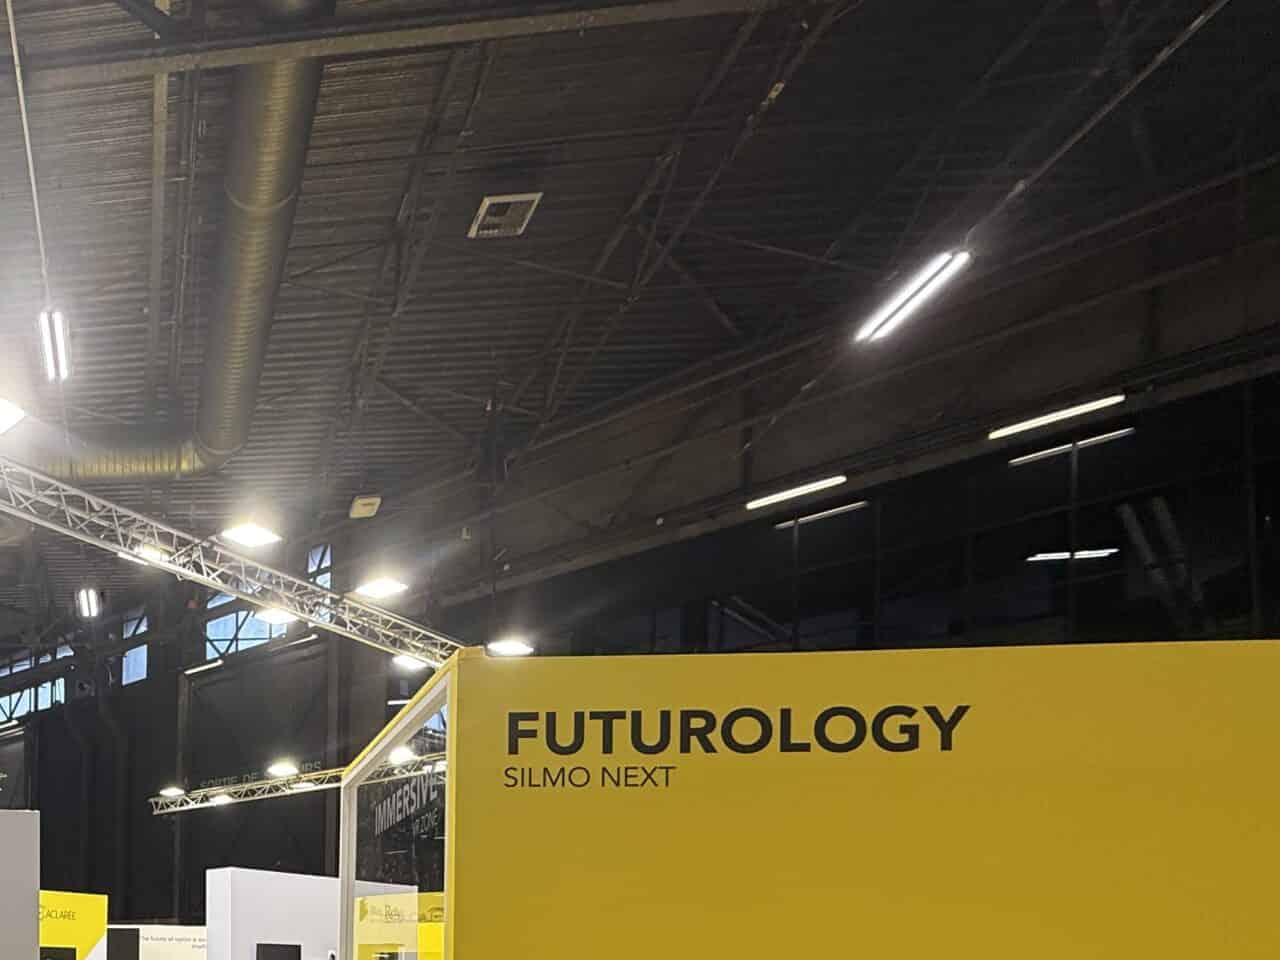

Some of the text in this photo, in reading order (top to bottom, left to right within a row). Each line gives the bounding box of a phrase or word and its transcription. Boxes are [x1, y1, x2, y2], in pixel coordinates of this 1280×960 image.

[507, 705, 972, 756] FUTUROLOGY
[503, 765, 677, 788] SILMO NEXT
[375, 770, 437, 837] IMMERSIVE
